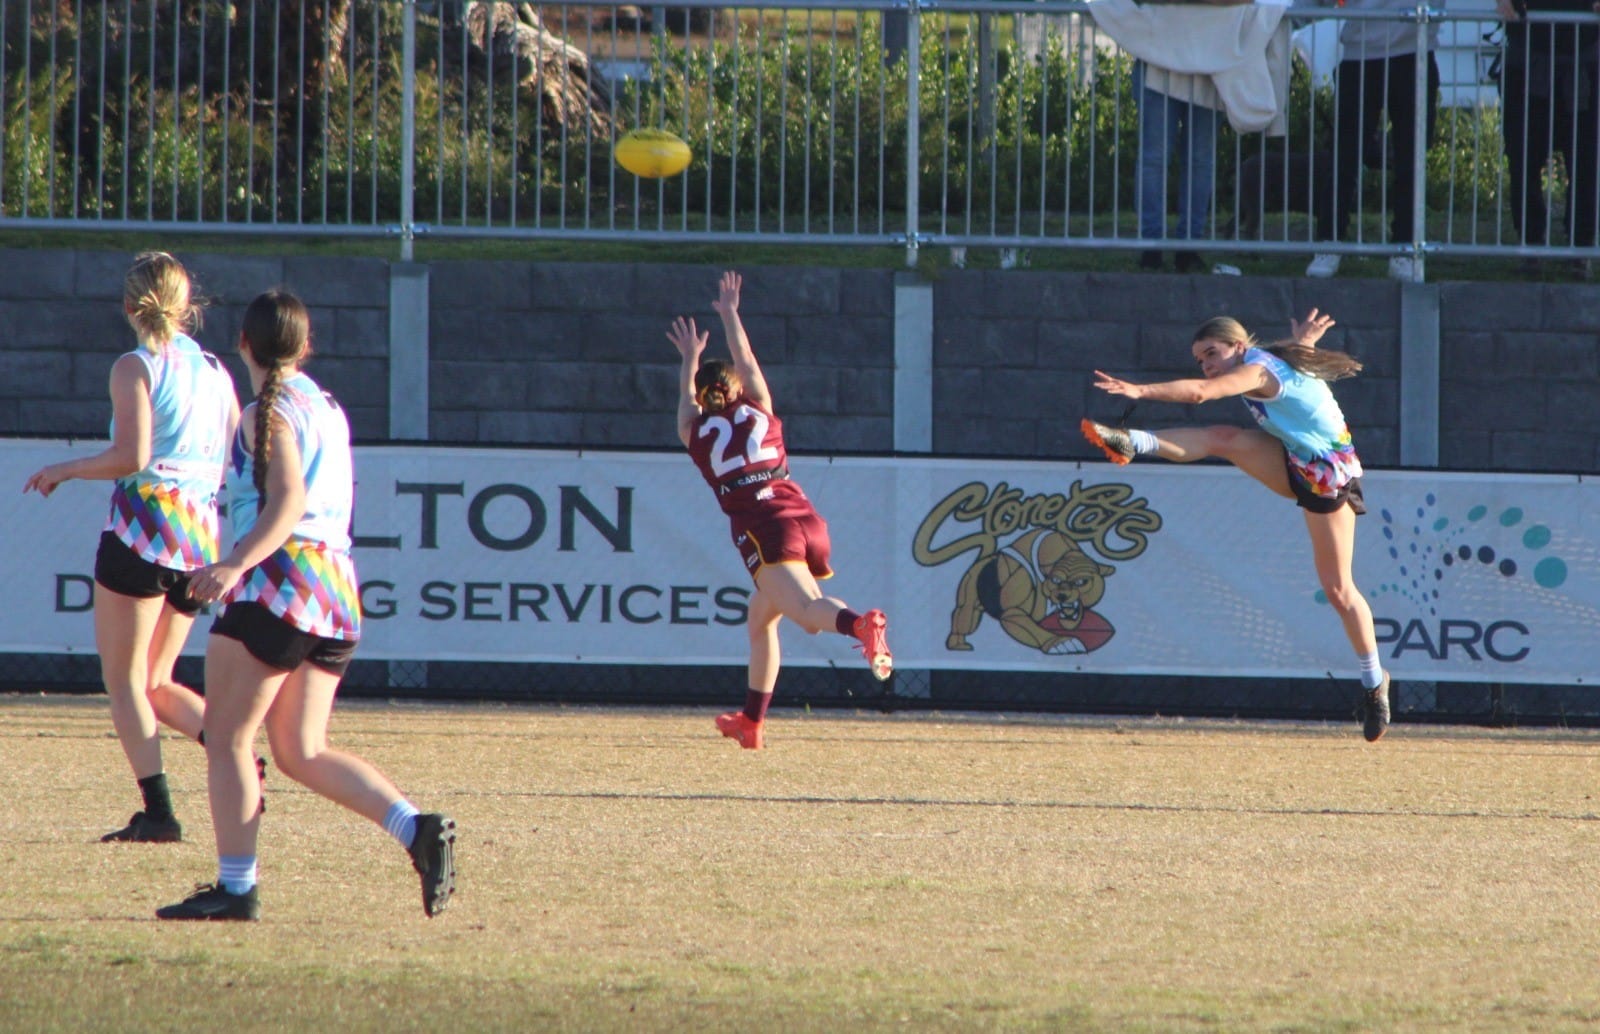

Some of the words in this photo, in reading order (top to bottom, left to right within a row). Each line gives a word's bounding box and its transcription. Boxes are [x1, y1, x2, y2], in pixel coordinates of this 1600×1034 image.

[698, 404, 779, 478] 22
[352, 480, 634, 552] LTON
[418, 580, 751, 626] SERVICES
[1373, 617, 1531, 663] PARC
